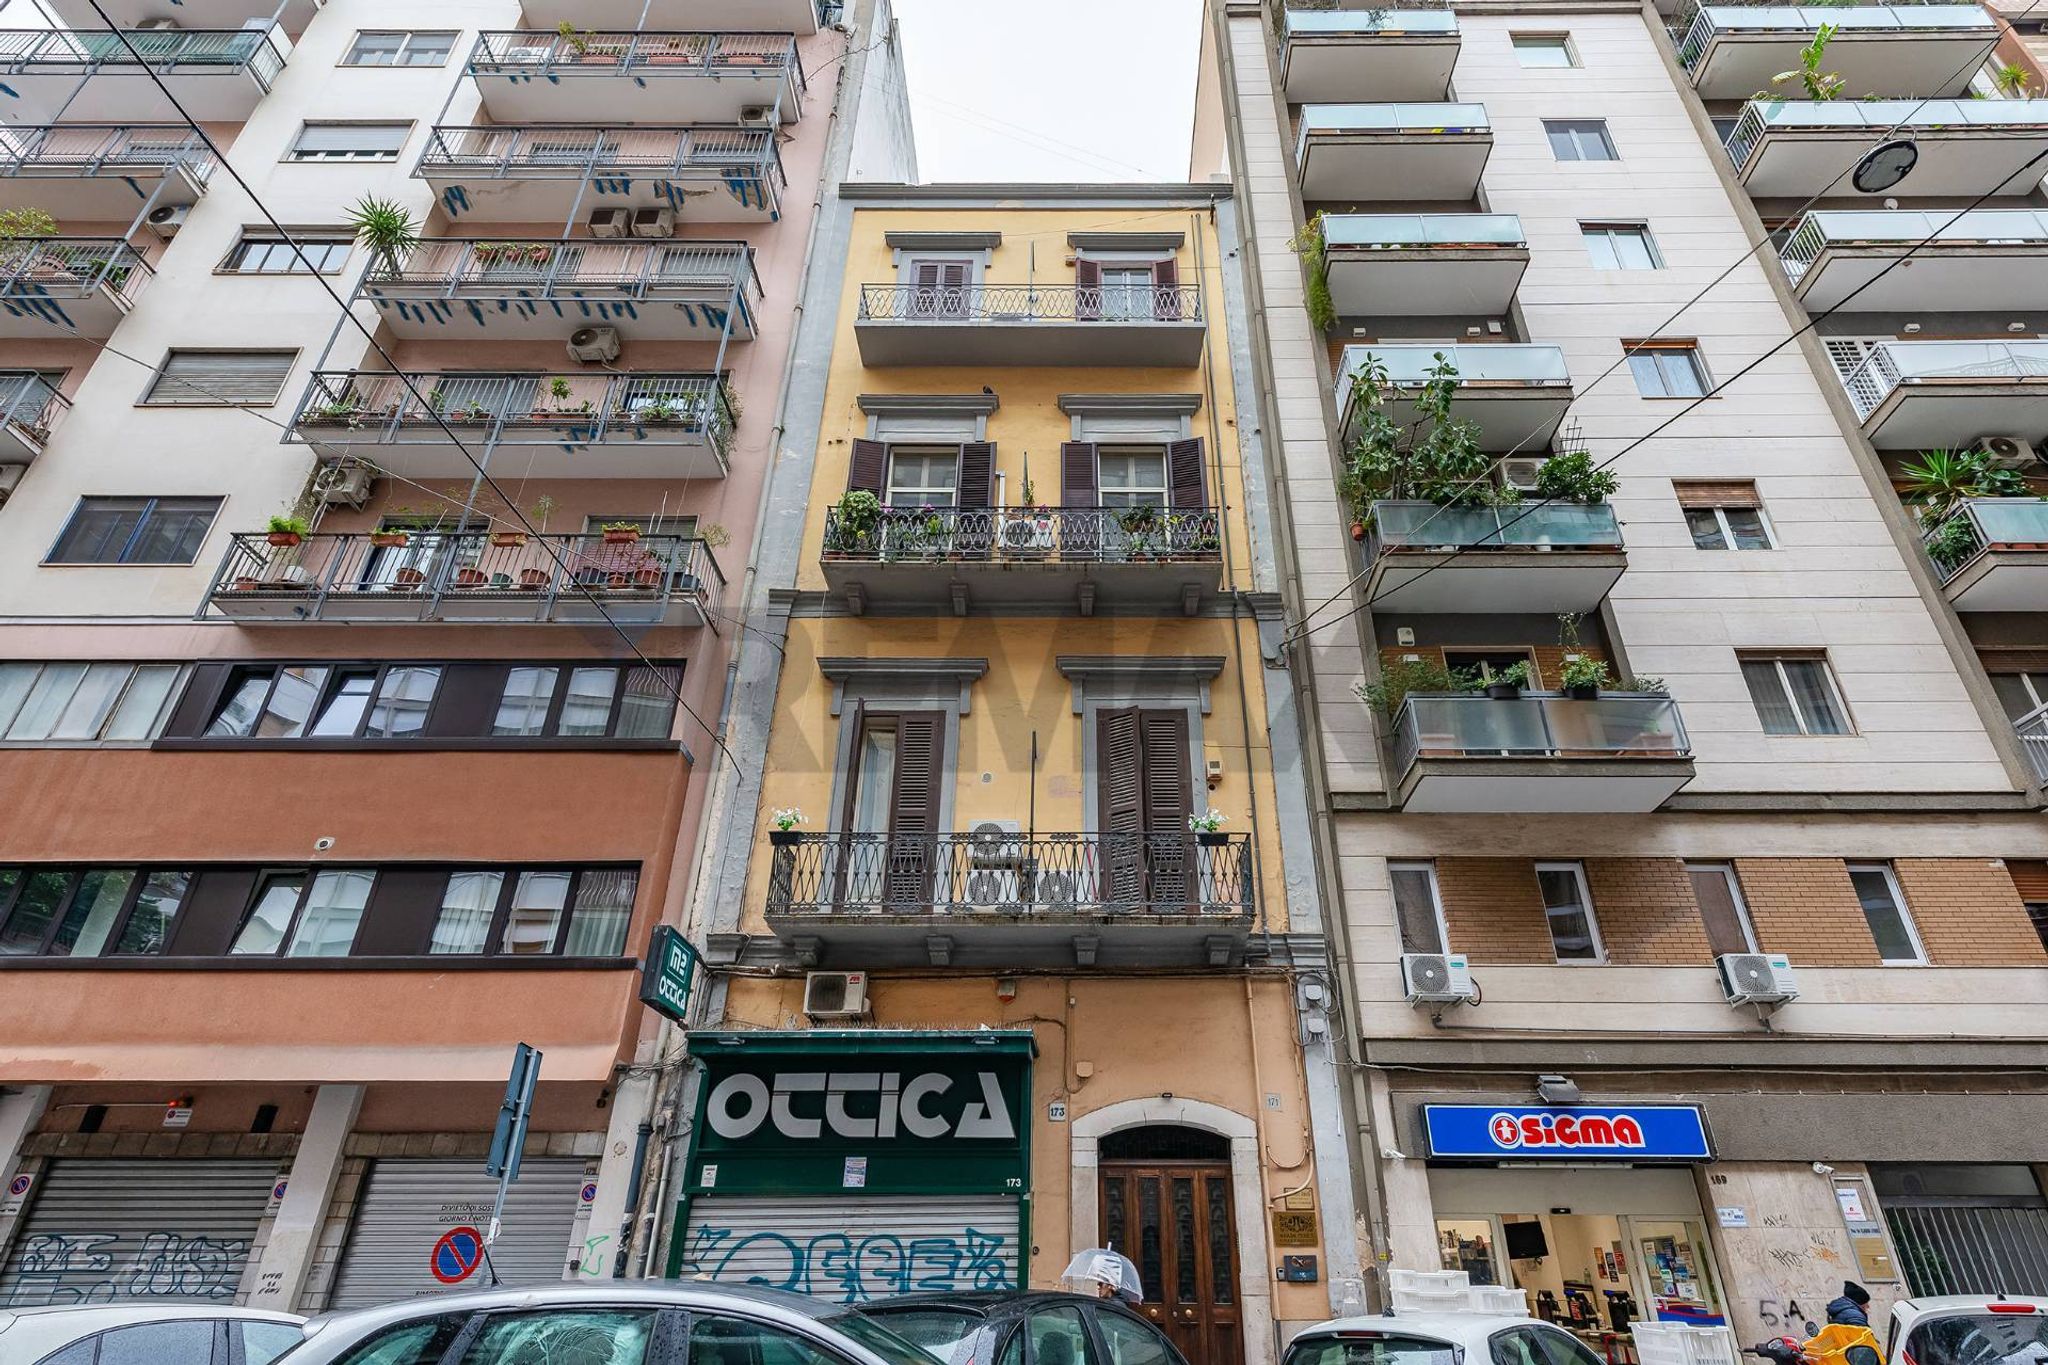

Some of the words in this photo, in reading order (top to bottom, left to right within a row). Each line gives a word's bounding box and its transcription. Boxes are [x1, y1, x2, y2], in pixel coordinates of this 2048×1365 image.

[707, 1072, 1016, 1139] OTTICA
[1051, 1107, 1065, 1117] 173
[1006, 1178, 1022, 1188] 173
[1710, 1175, 1728, 1185] 169
